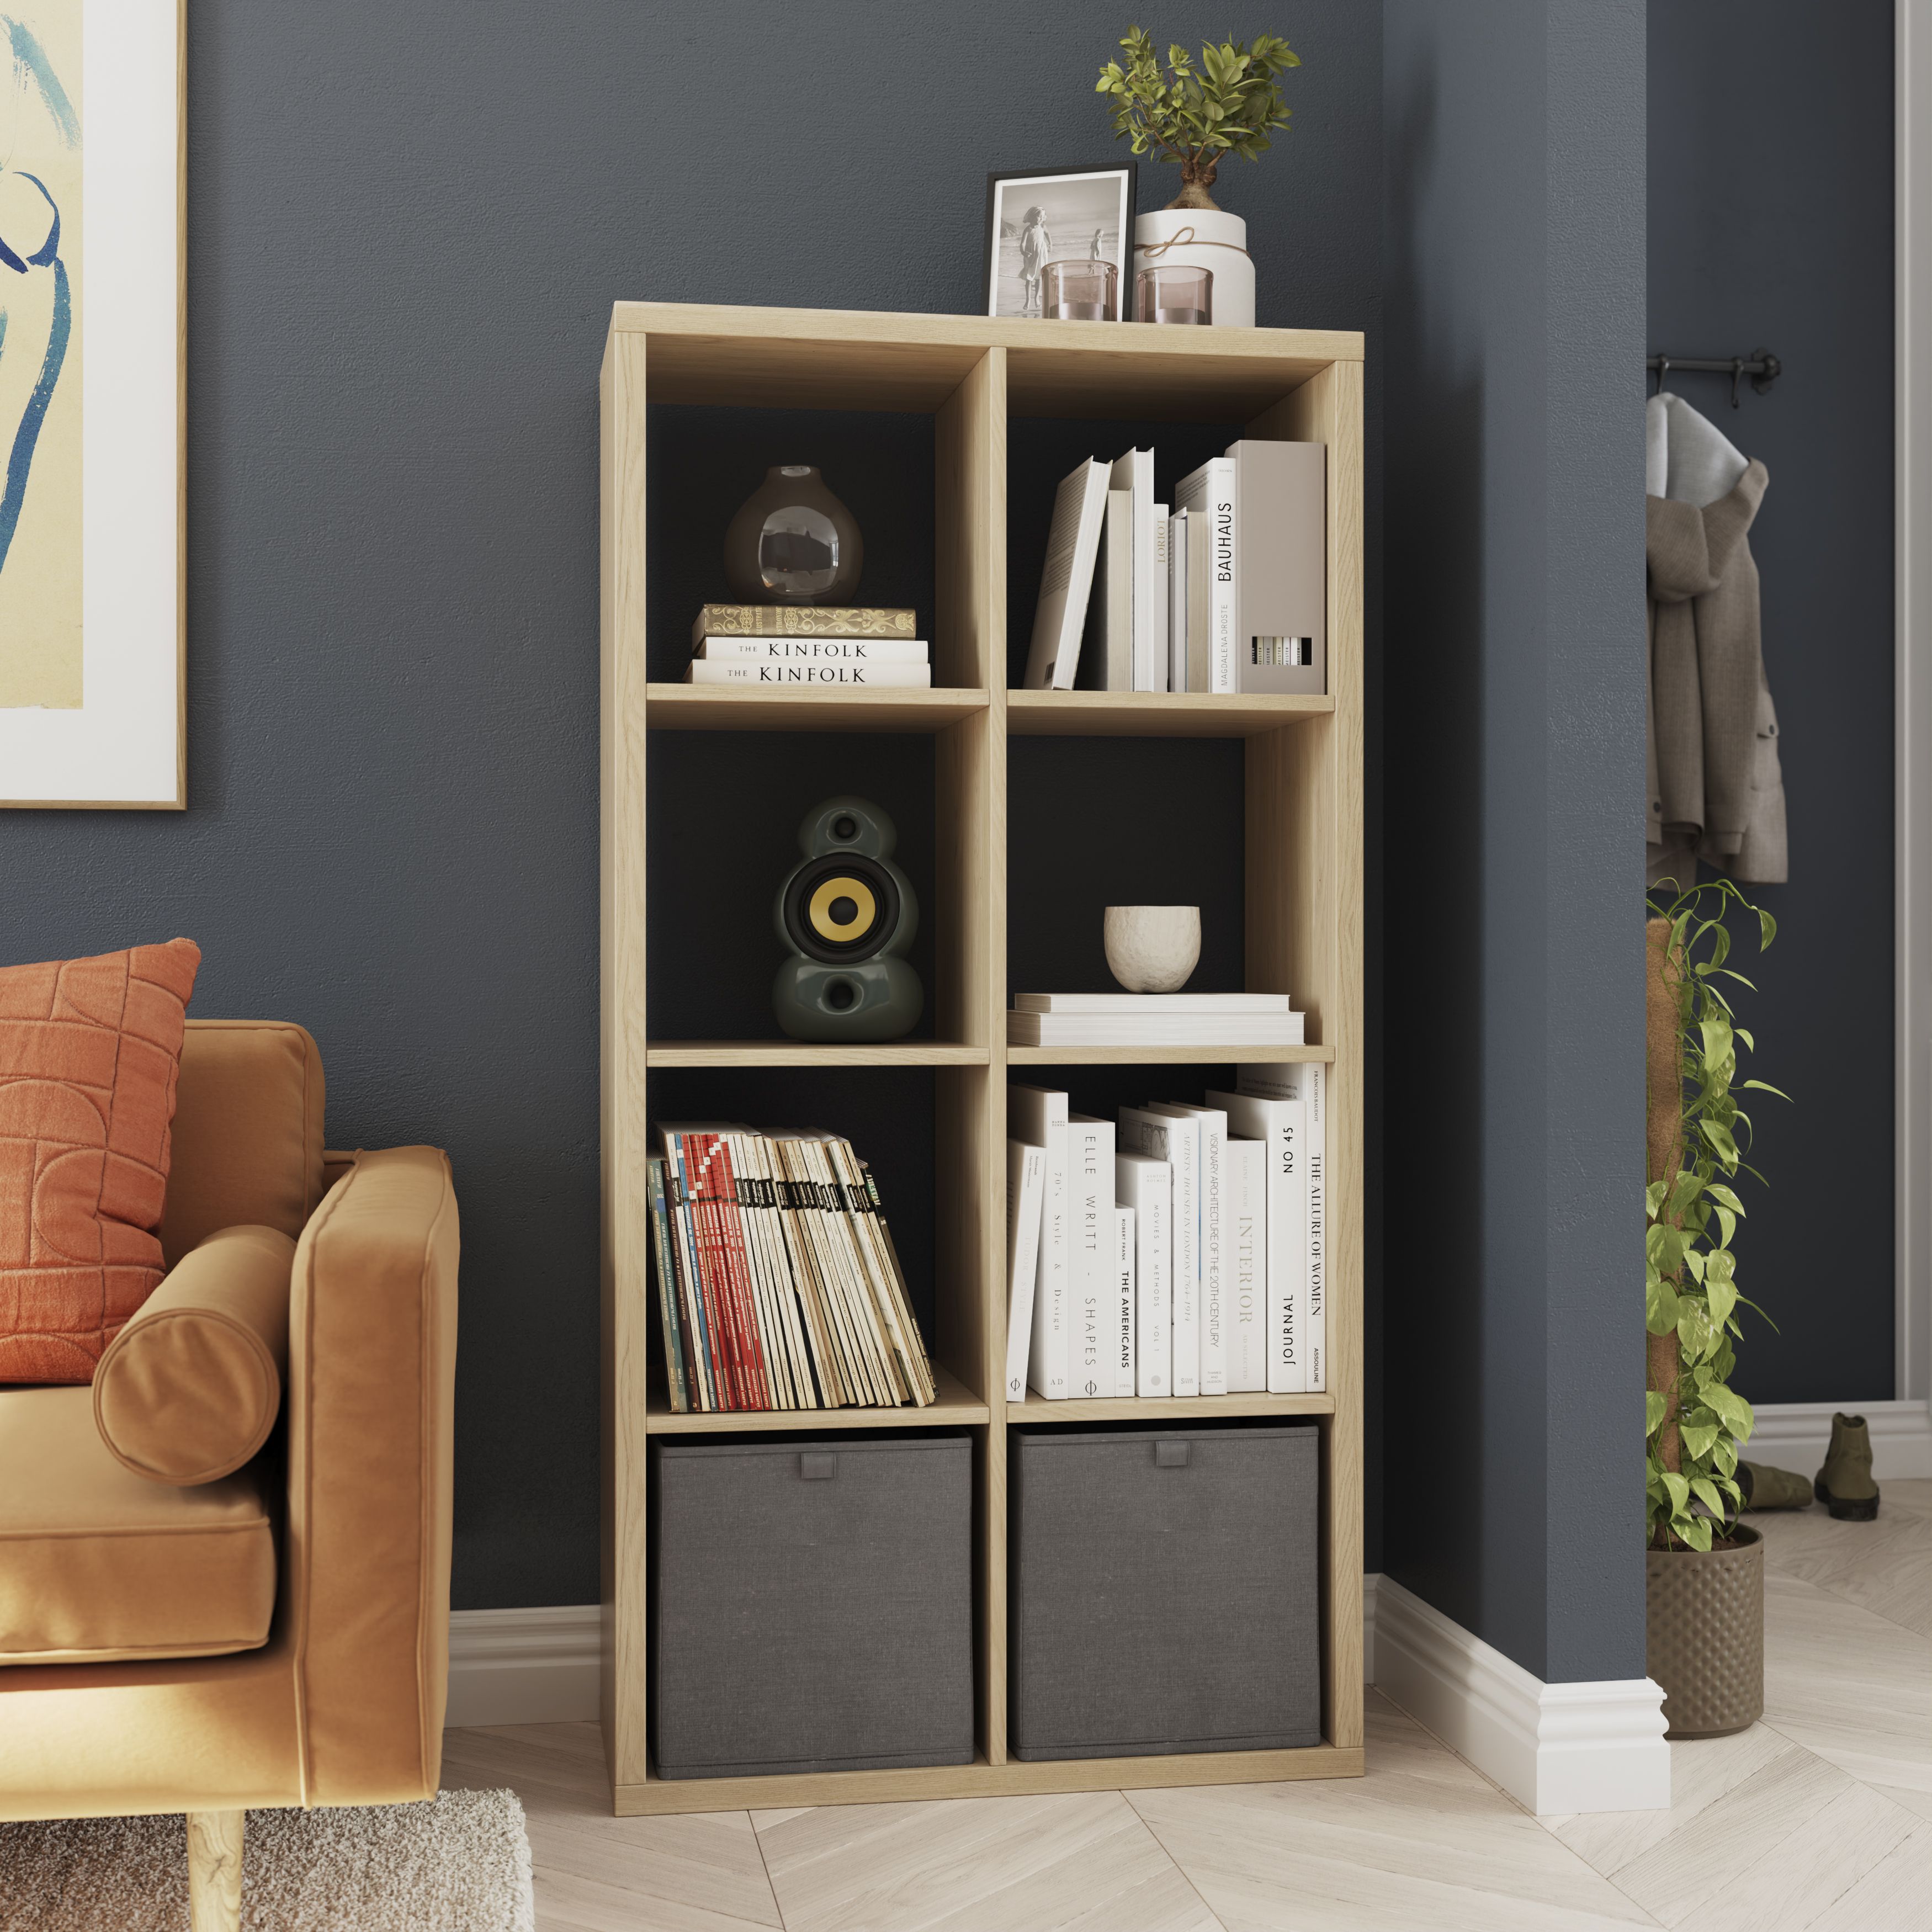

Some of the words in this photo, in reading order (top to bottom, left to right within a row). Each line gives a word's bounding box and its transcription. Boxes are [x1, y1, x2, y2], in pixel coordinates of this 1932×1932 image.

[1157, 518, 1165, 562] LORIOT
[1218, 503, 1231, 581] BAUHAUS
[768, 643, 868, 658] KINFOLK
[759, 667, 866, 683] KINFOLK
[1283, 1128, 1293, 1143] 45
[1085, 1137, 1096, 1175] ELLE
[1210, 1133, 1218, 1175] VISIONARY
[1283, 1151, 1293, 1173] NO
[1311, 1154, 1321, 1182] THE
[1085, 1196, 1096, 1251] WRITT
[1183, 1217, 1191, 1228] IN
[1210, 1176, 1219, 1241] ARCHITECTURE
[1311, 1185, 1321, 1238] ALLURE
[1053, 1215, 1061, 1245] Style
[1022, 1236, 1031, 1271] TUDOR
[1210, 1243, 1219, 1254] OF
[1210, 1257, 1219, 1273] THE
[1311, 1241, 1321, 1259] OF
[1210, 1276, 1219, 1301] 20TH
[1239, 1217, 1252, 1325] INTERIOR
[1311, 1262, 1321, 1315] WOMEN
[1018, 1282, 1027, 1313] STYLE
[1053, 1289, 1061, 1330] Design
[1085, 1298, 1096, 1366] SHAPES
[1210, 1302, 1219, 1347] CENTURY
[1243, 1334, 1248, 1343] AD
[1283, 1294, 1296, 1365] JOURNAL
